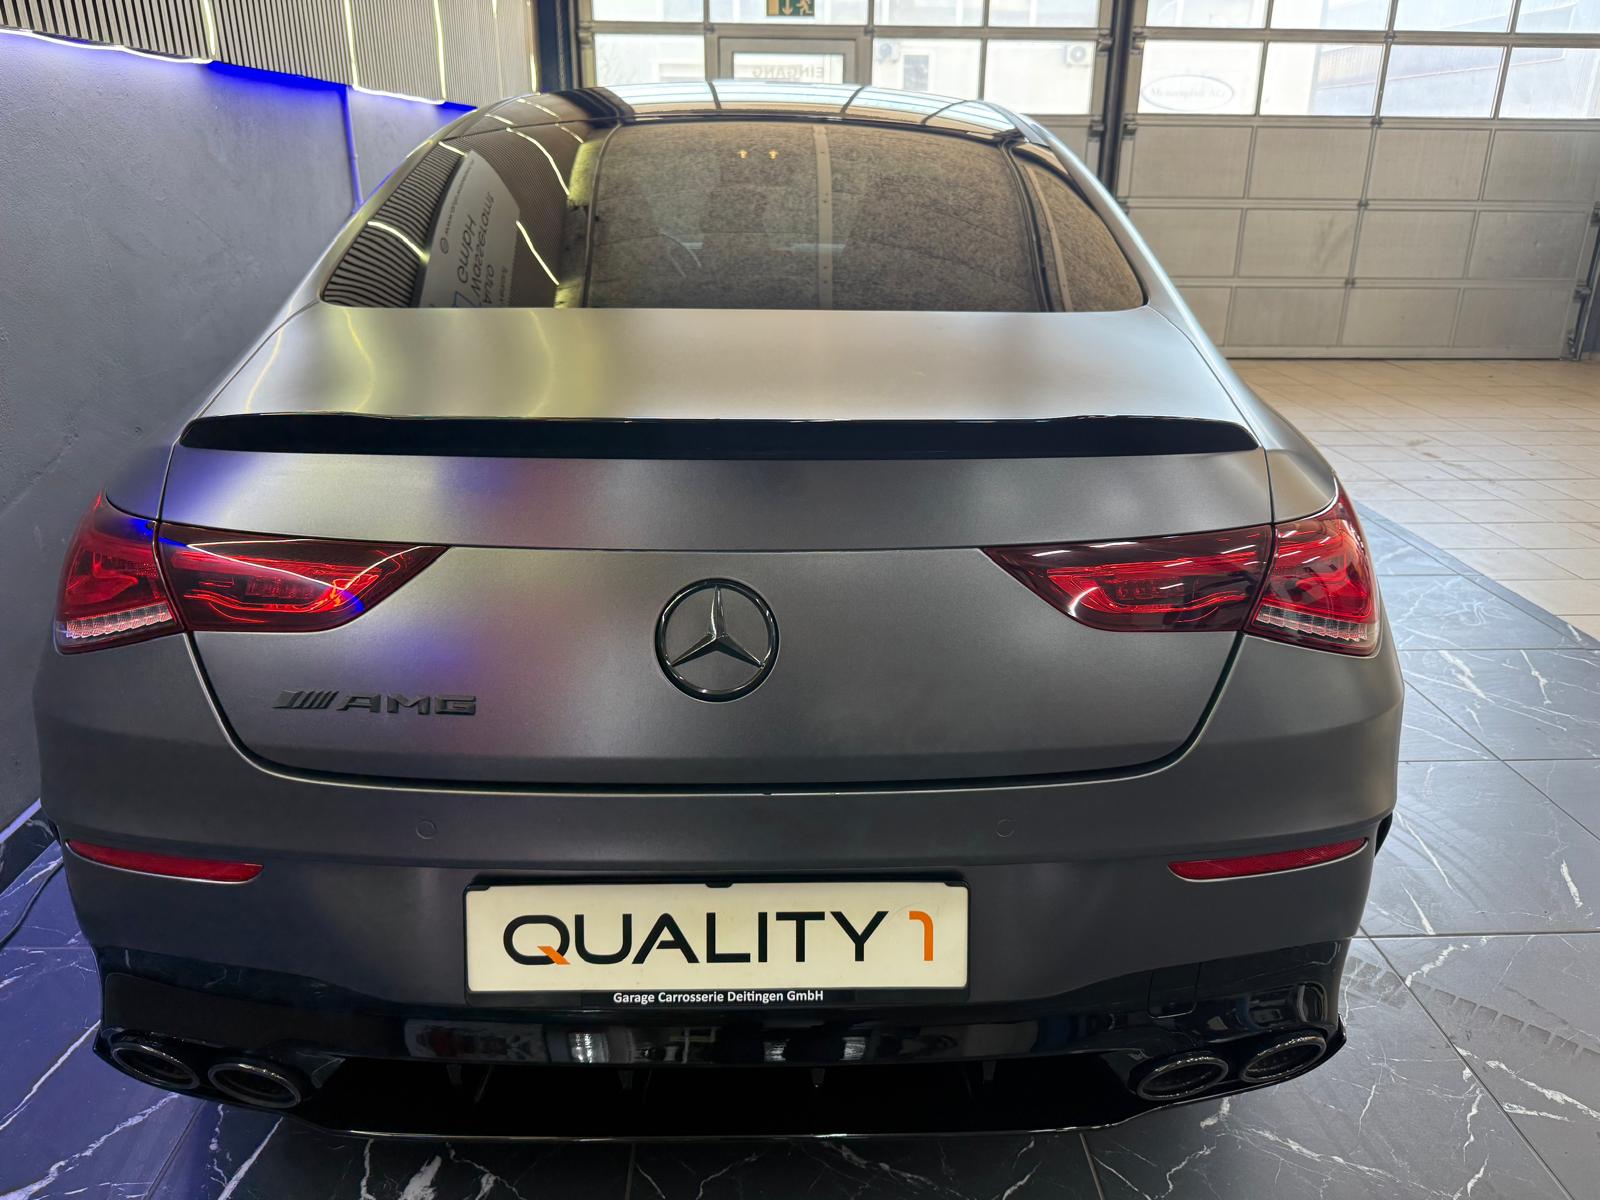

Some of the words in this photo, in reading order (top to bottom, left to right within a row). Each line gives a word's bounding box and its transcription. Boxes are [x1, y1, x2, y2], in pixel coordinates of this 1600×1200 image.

[336, 693, 477, 716] AMG
[502, 911, 889, 966] QUALITY
[612, 991, 655, 1005] Garage
[657, 990, 725, 1003] Carrosserie
[727, 990, 784, 1005] Deitingen
[786, 989, 825, 1003] GmbH
